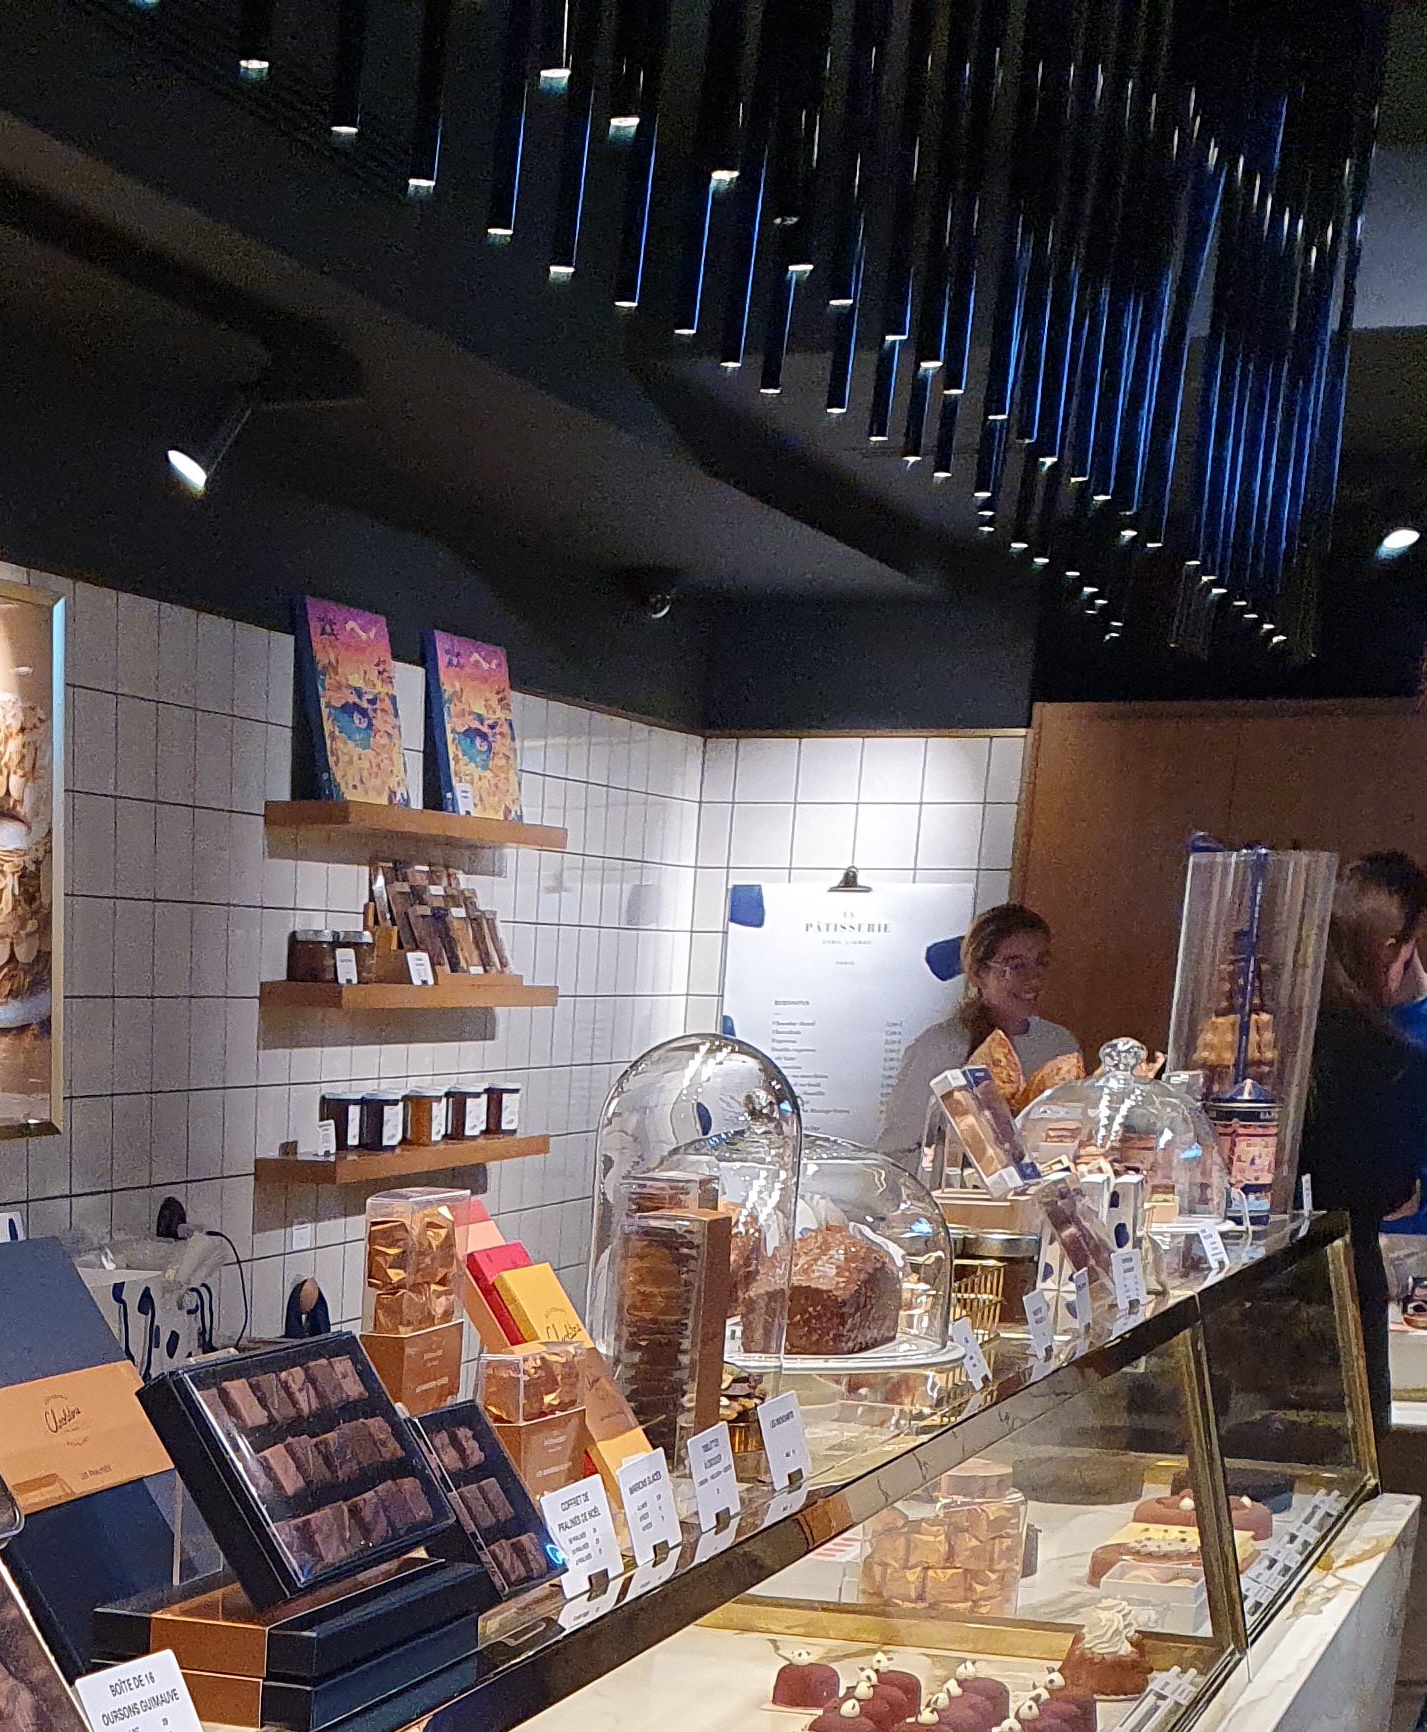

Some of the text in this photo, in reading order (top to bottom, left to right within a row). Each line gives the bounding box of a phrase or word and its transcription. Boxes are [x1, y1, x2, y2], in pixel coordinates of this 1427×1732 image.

[805, 921, 891, 933] PÂTISSERIE
[109, 1678, 133, 1697] BOÎTE
[133, 1675, 145, 1689] DE
[101, 1688, 180, 1726] OURSONS GUIMAUVE
